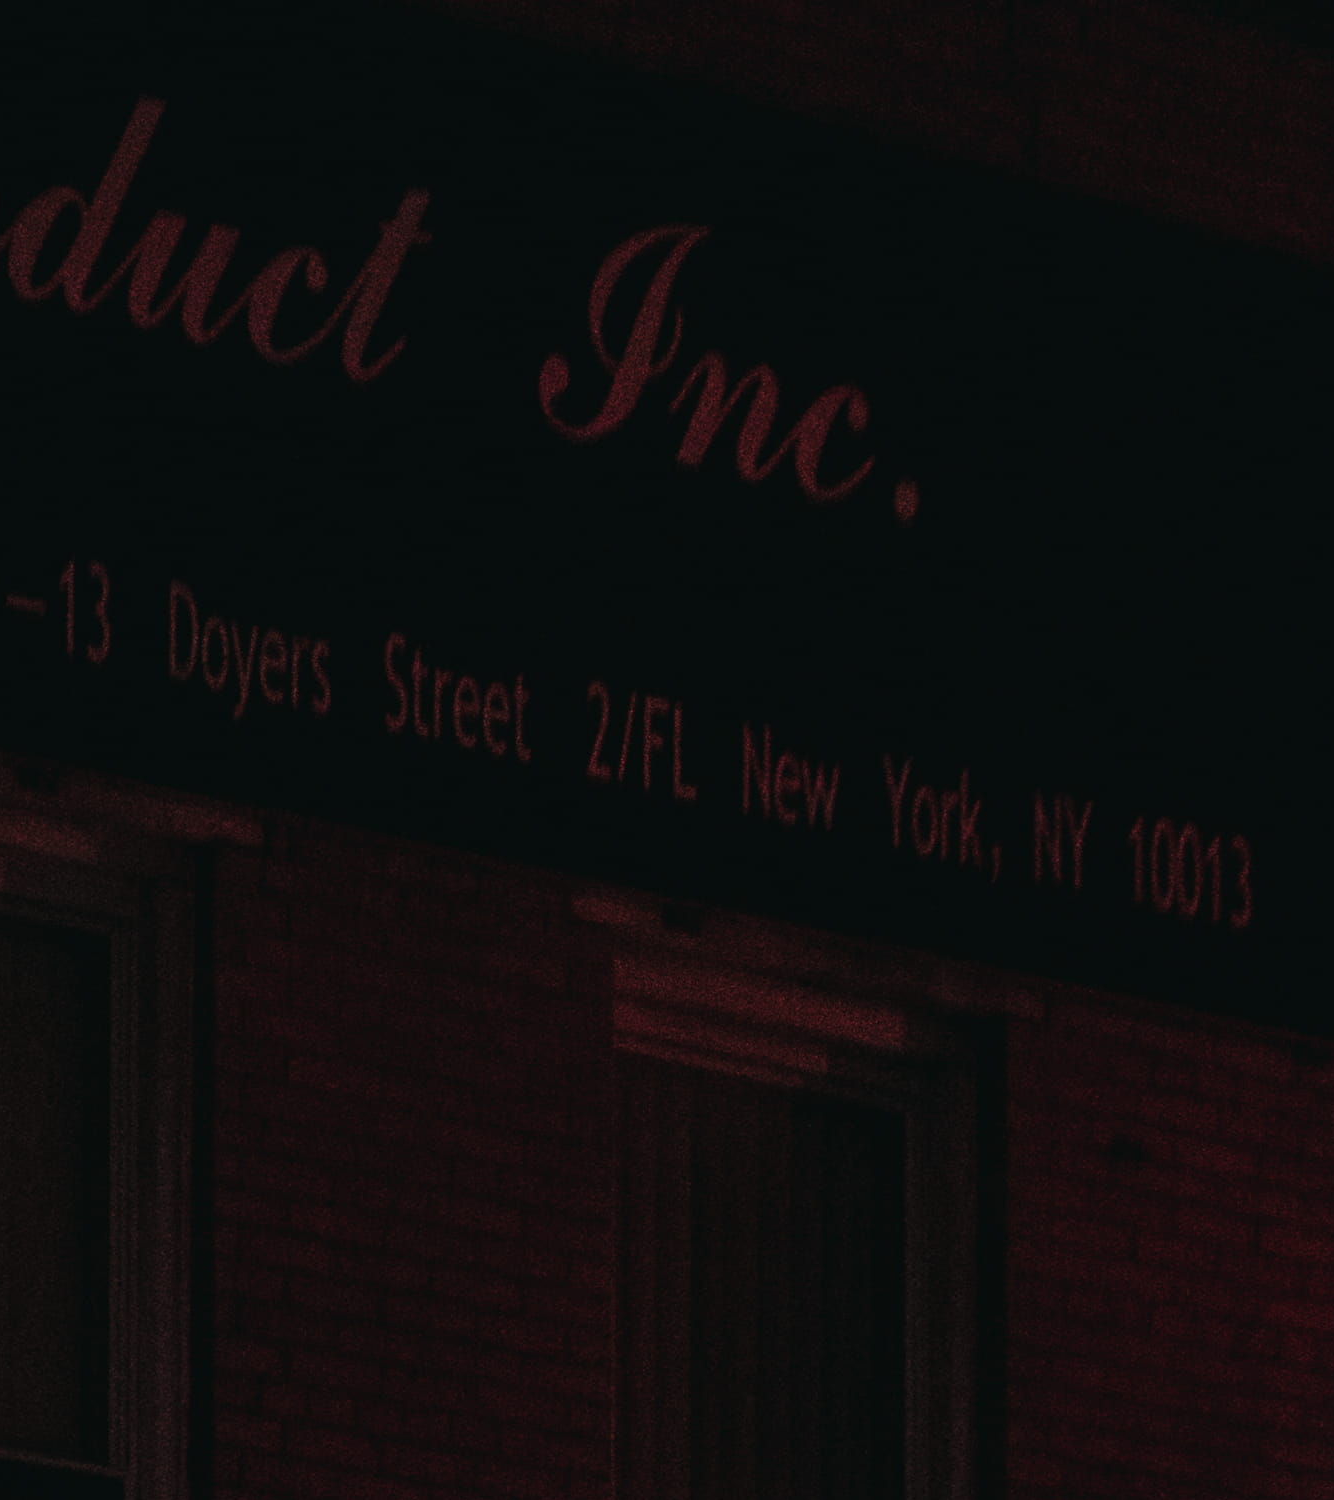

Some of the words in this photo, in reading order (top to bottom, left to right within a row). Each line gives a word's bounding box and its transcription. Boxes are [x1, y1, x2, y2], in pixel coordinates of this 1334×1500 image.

[538, 222, 921, 527] Inc.
[168, 578, 332, 721] Doyers
[384, 631, 532, 765] Street
[585, 678, 699, 801] 2/FL
[740, 720, 842, 832] New
[882, 752, 1003, 885] York,
[1033, 788, 1095, 893] NY
[1127, 814, 1254, 930] 10013
